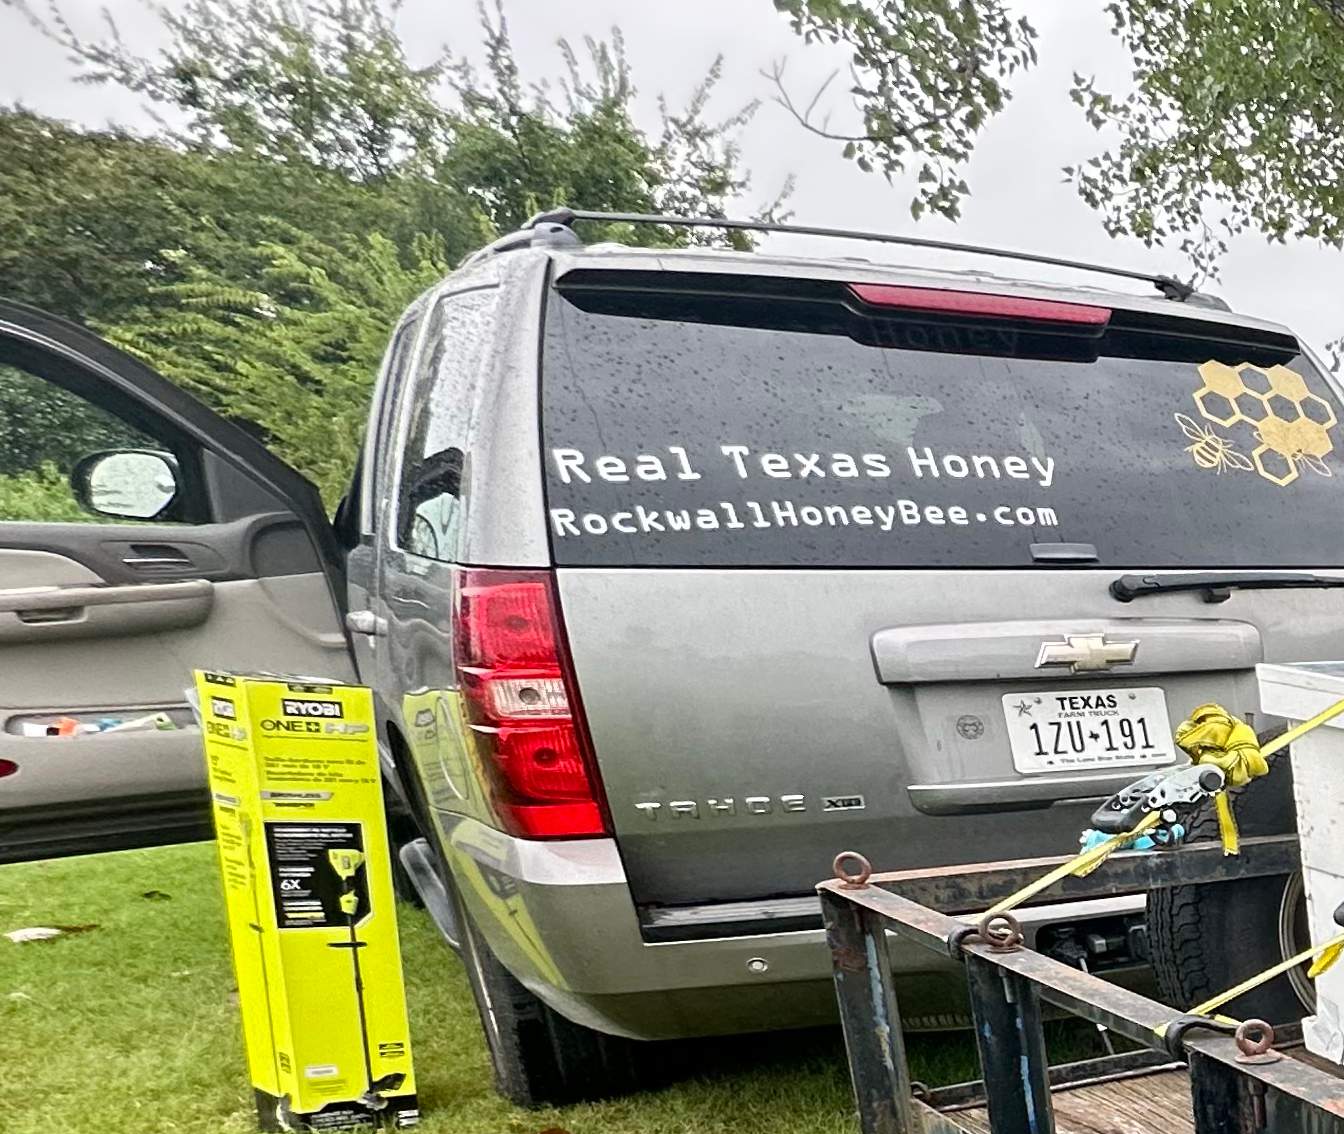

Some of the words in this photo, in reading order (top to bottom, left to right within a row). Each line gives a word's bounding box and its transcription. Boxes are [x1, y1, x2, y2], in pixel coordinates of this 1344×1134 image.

[551, 446, 700, 485] Real
[721, 445, 892, 479] Texas
[908, 446, 1057, 486] Honey
[550, 498, 1059, 537] RockwallHoneyBee.com
[284, 700, 341, 717] RYOBI
[1056, 694, 1118, 711] TEXAS
[1057, 711, 1086, 719] FARM
[1088, 709, 1120, 718] TRUCK
[634, 794, 807, 821] TAHOE
[280, 878, 301, 891] 6X
